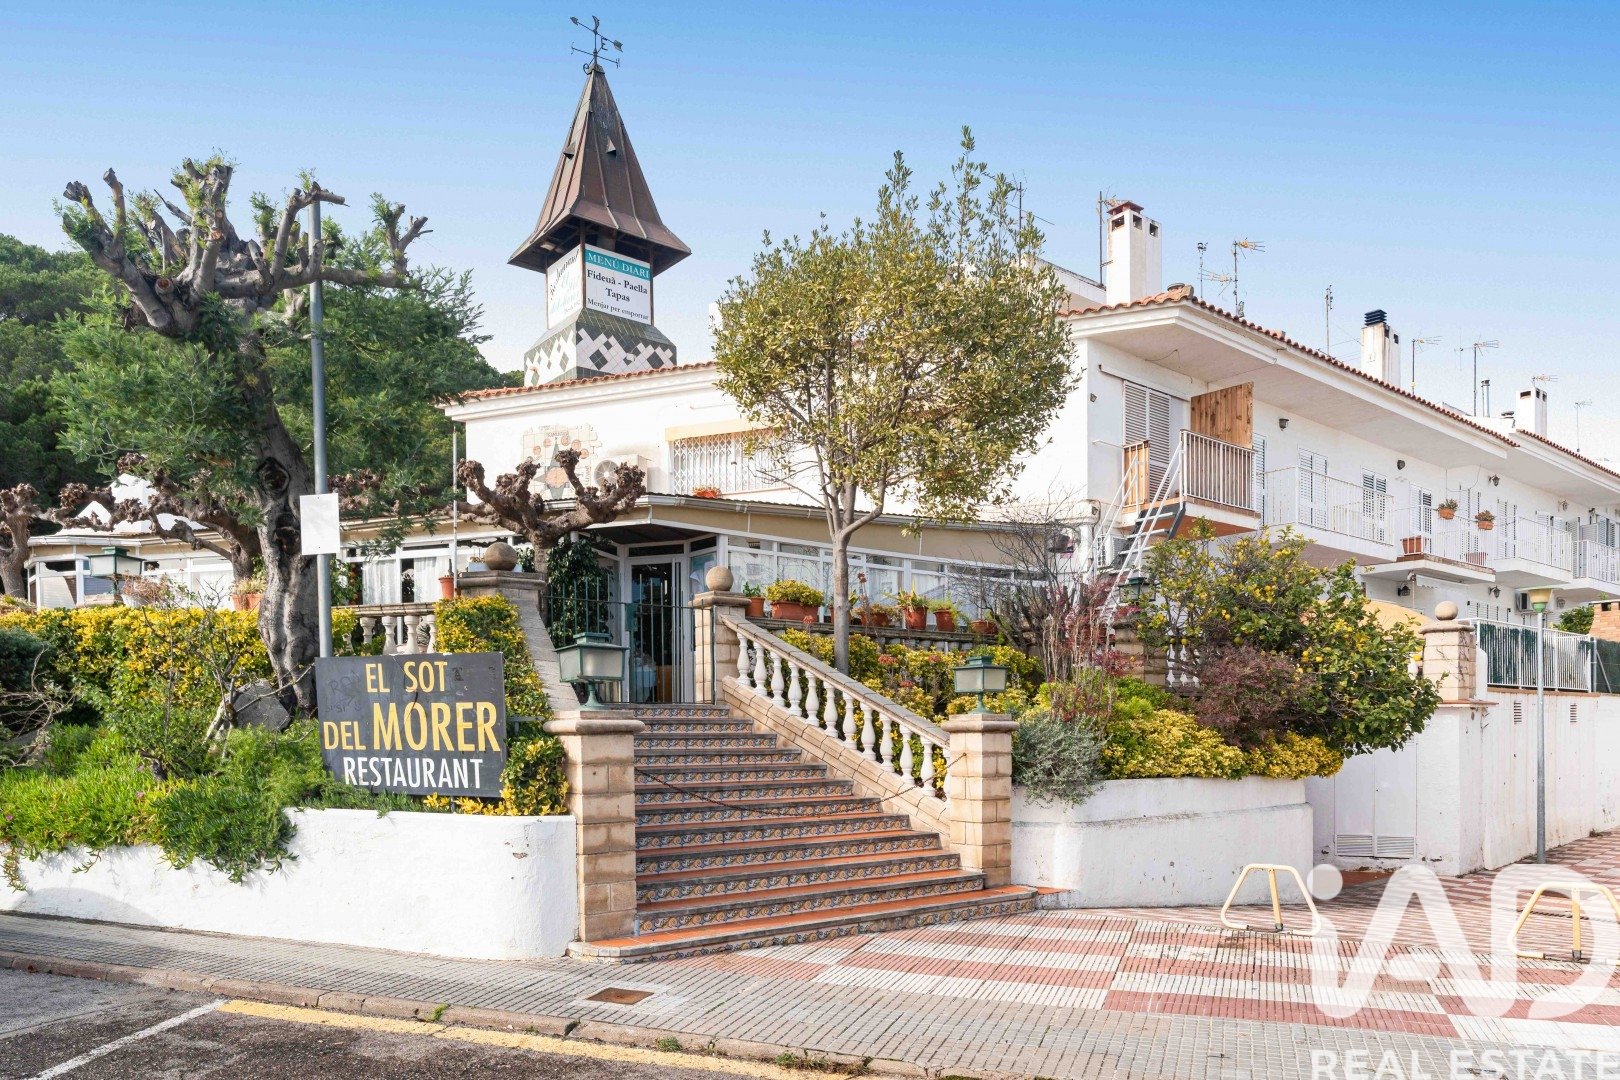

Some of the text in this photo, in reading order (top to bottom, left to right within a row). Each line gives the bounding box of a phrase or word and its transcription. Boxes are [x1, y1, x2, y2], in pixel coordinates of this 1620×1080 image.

[588, 252, 650, 279] MENÚ DIARI
[587, 269, 616, 285] Fideuà
[623, 279, 648, 295] Paella
[605, 287, 630, 302] Tapas
[587, 297, 649, 320] Menjar per emportar
[365, 663, 391, 693] EL
[403, 661, 448, 693] SOT
[323, 701, 501, 752] DEL MORER
[343, 757, 483, 789] RESTAURANT
